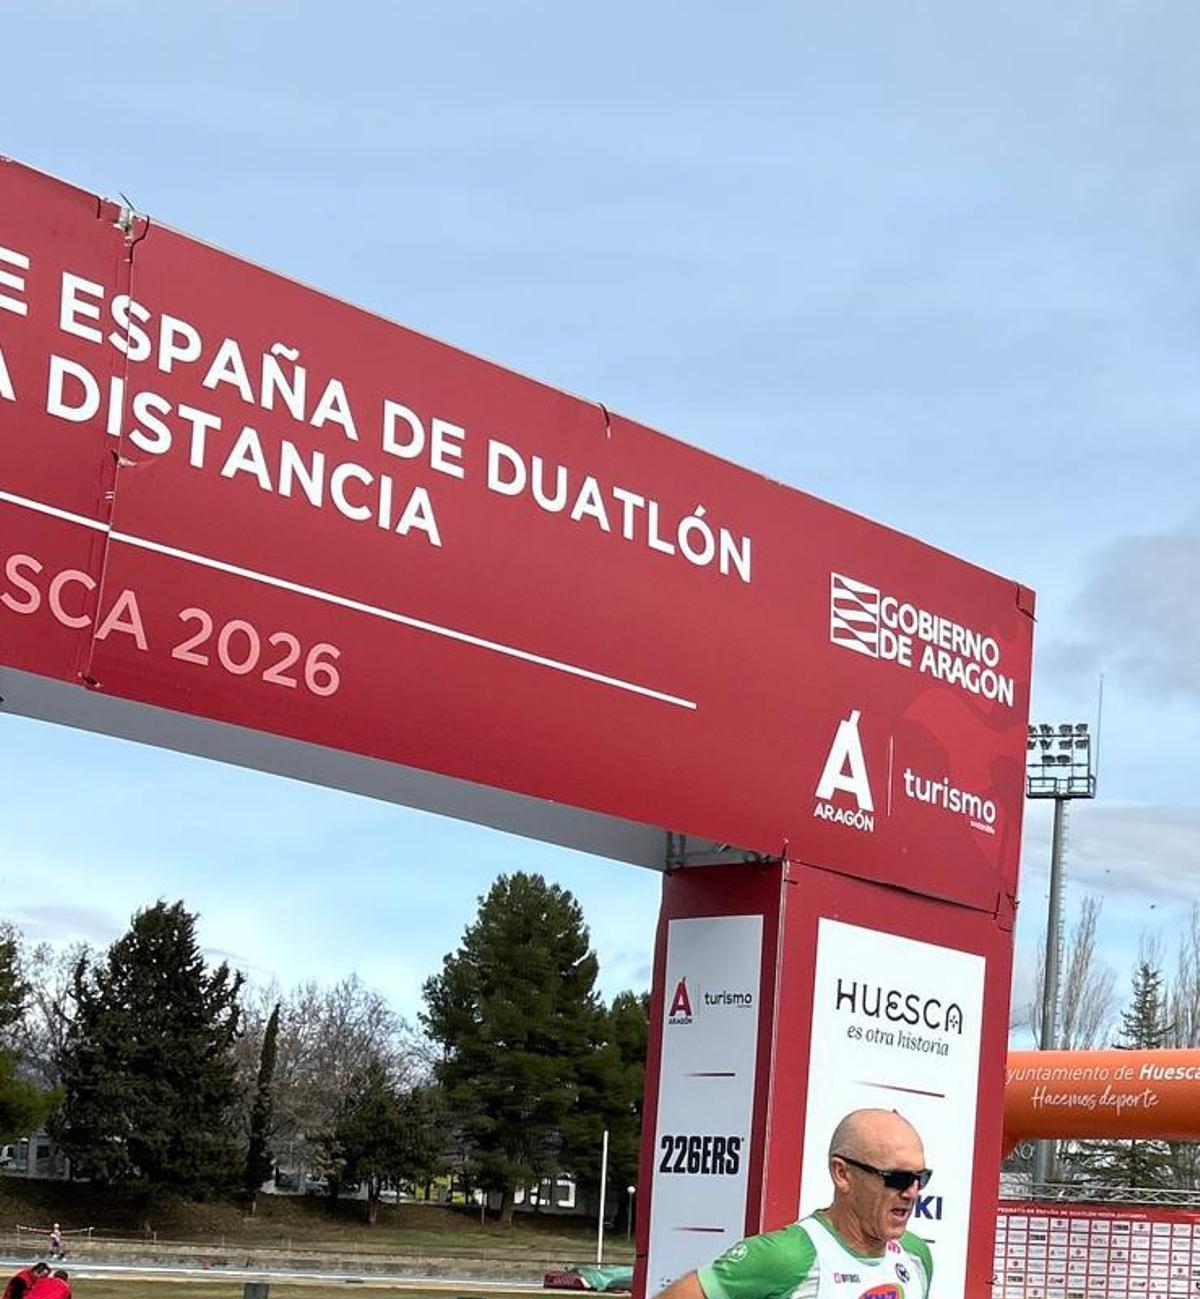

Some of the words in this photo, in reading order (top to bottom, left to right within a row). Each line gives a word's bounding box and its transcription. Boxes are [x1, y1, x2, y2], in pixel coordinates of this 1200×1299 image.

[46, 353, 443, 547] DISTANCIA
[59, 271, 360, 442] ESPAÑA
[382, 399, 466, 479] DE
[487, 438, 752, 584] DUATLÓN
[171, 606, 342, 698] 2026
[880, 596, 1000, 668] GOBIERNO
[879, 628, 912, 668] DE
[919, 645, 1014, 708] ARAGON
[813, 802, 875, 832] ARAGÓN
[903, 767, 996, 824] turismo
[704, 989, 753, 1006] turismo
[835, 978, 963, 1035] HUESCA
[846, 1024, 863, 1040] es
[865, 1026, 895, 1046] otra
[897, 1029, 950, 1056] historia
[1005, 1066, 1110, 1085] yuntamiento
[1114, 1065, 1134, 1081] de
[1030, 1085, 1096, 1111] Hacemos
[1098, 1084, 1160, 1117] deporte
[659, 1135, 742, 1175] 226ERS
